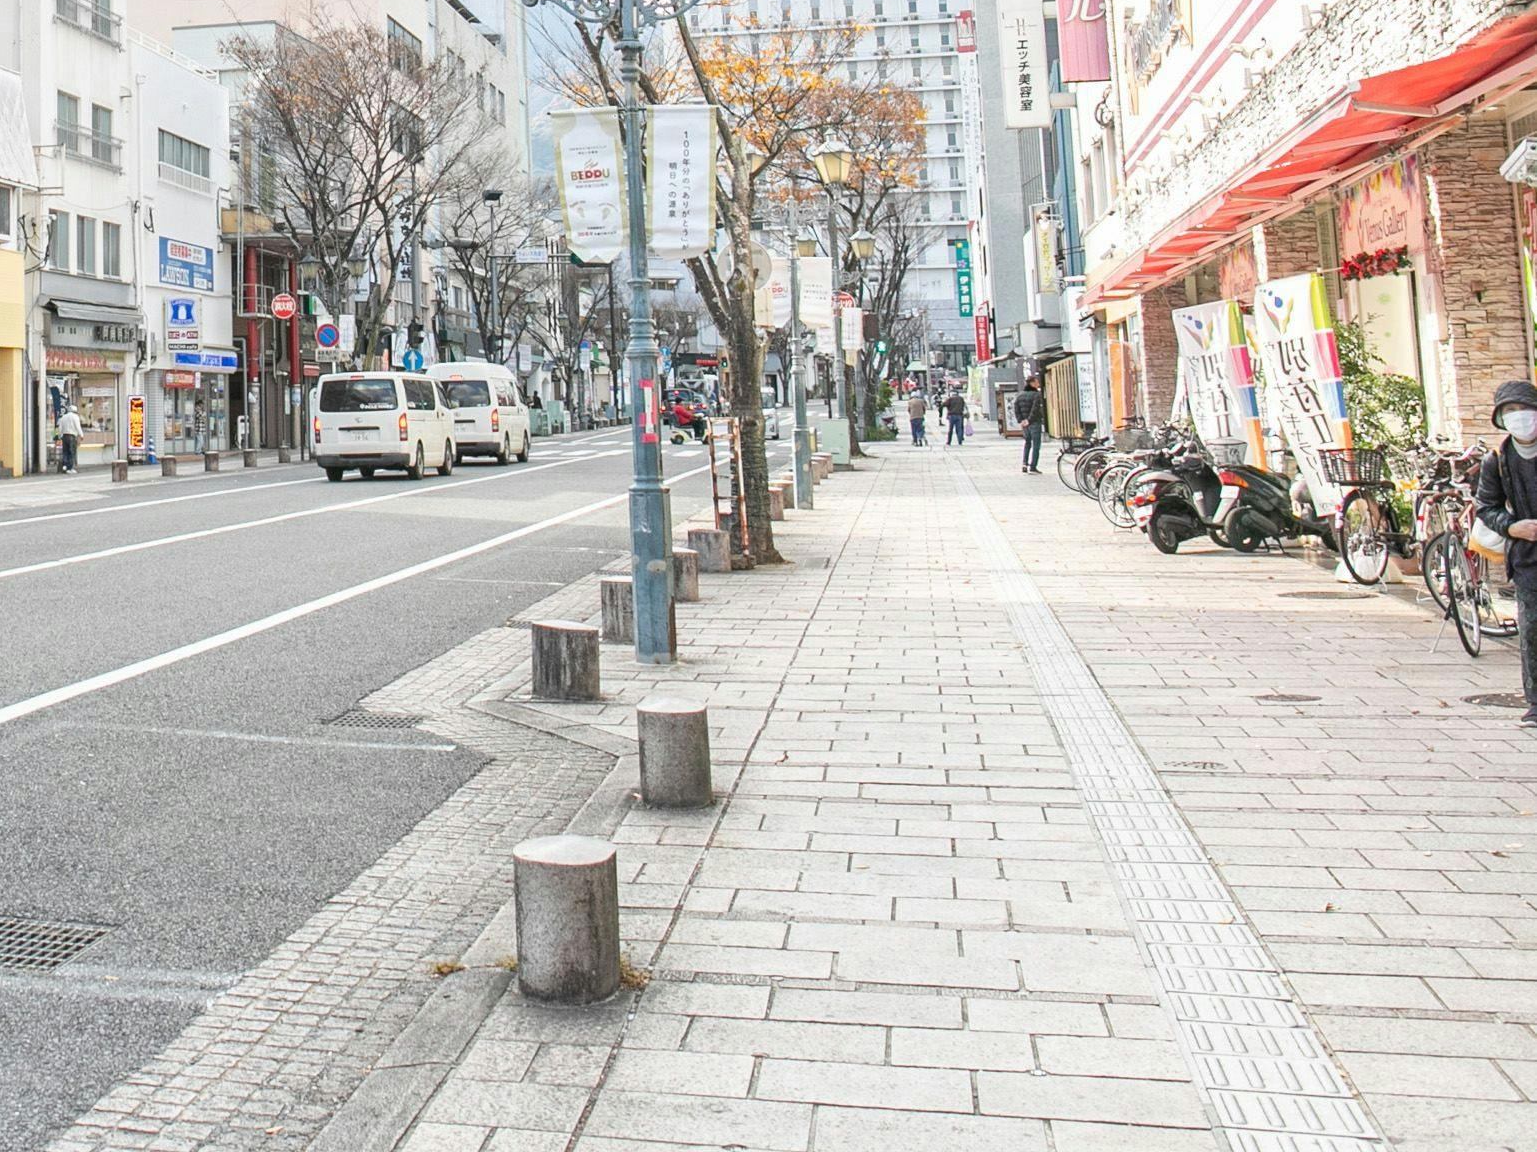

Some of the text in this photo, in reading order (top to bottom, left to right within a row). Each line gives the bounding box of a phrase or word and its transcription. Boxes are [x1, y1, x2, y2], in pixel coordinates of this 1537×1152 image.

[1016, 39, 1033, 112] エッチ美容室
[668, 162, 678, 218] 明日への源泉
